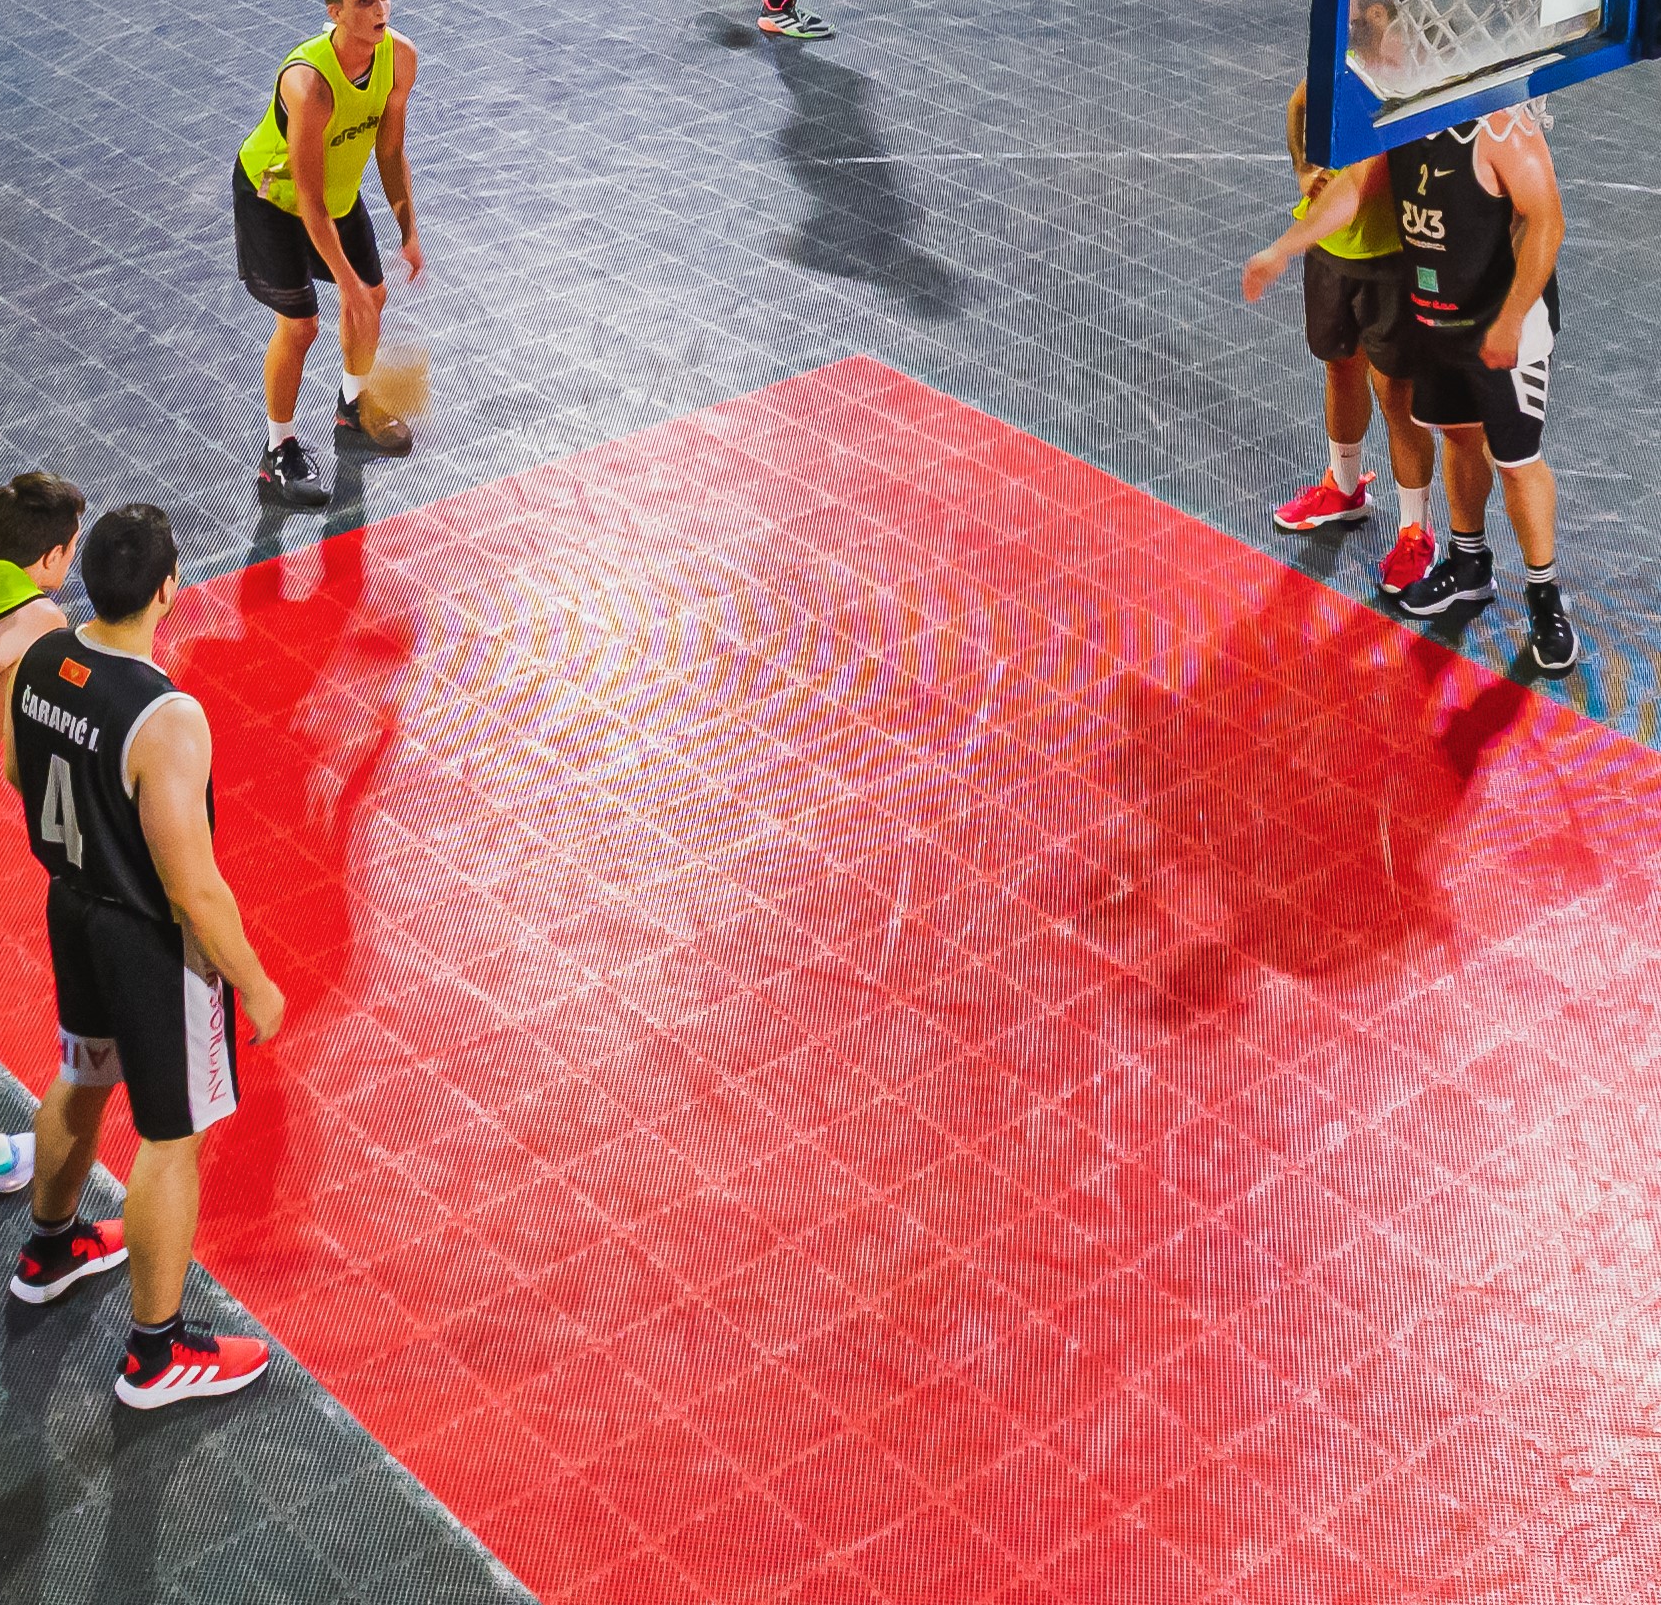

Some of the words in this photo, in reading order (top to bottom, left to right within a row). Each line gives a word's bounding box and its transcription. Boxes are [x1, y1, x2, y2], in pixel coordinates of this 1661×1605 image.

[1417, 163, 1429, 196] 2
[21, 684, 87, 746] ČARAPIĆ
[41, 753, 83, 870] 4
